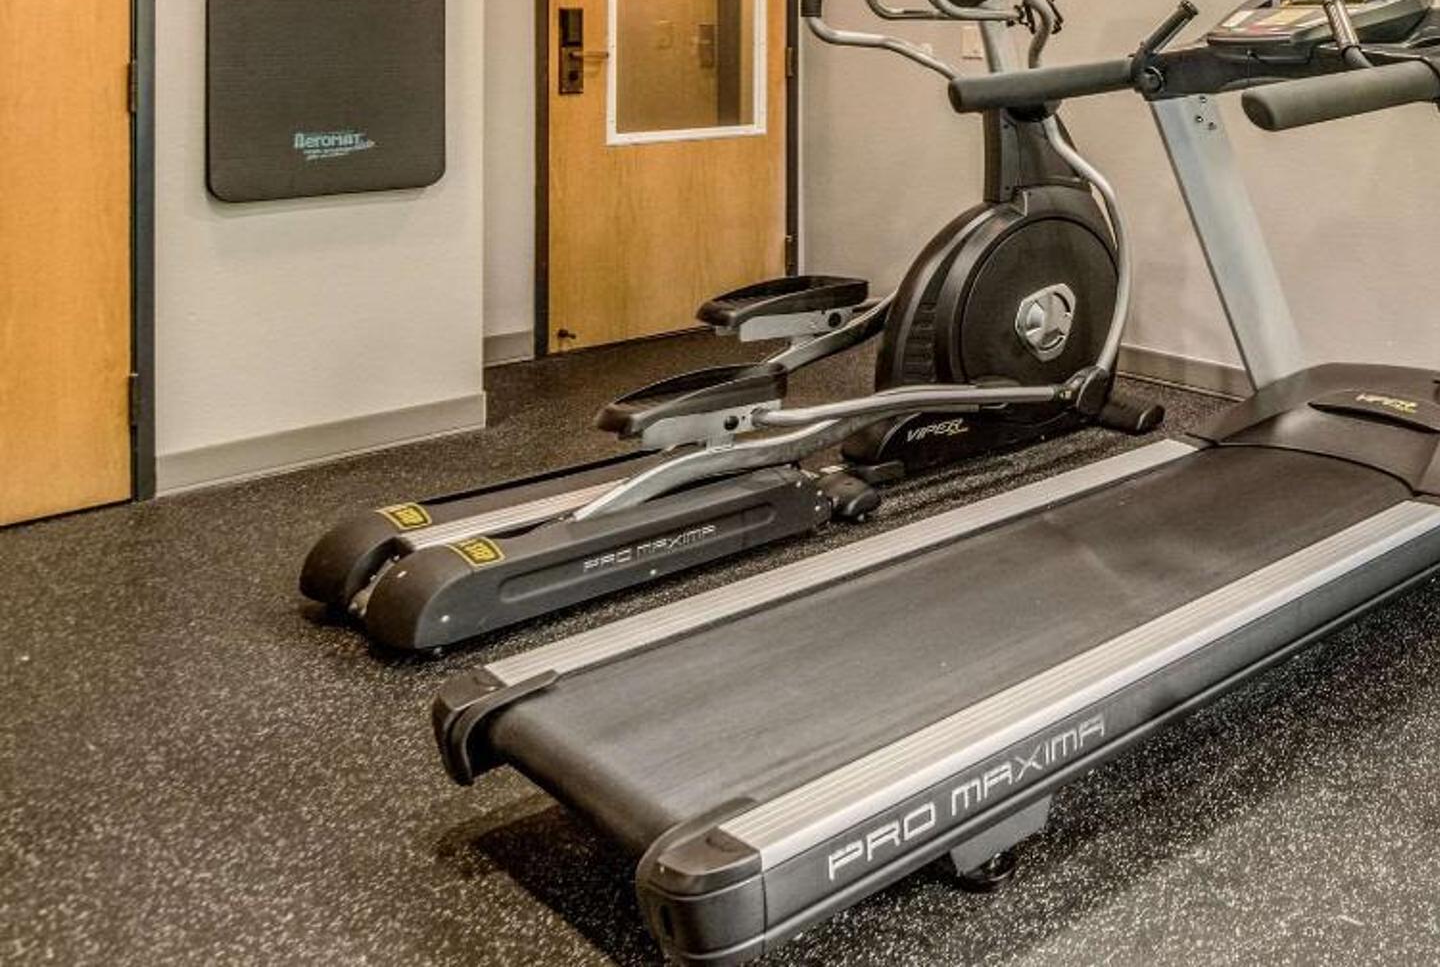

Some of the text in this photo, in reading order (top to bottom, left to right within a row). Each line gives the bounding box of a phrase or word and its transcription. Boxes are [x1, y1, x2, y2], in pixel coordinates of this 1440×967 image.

[583, 547, 632, 573] PRO
[828, 712, 1106, 881] PRO MAXIMA
